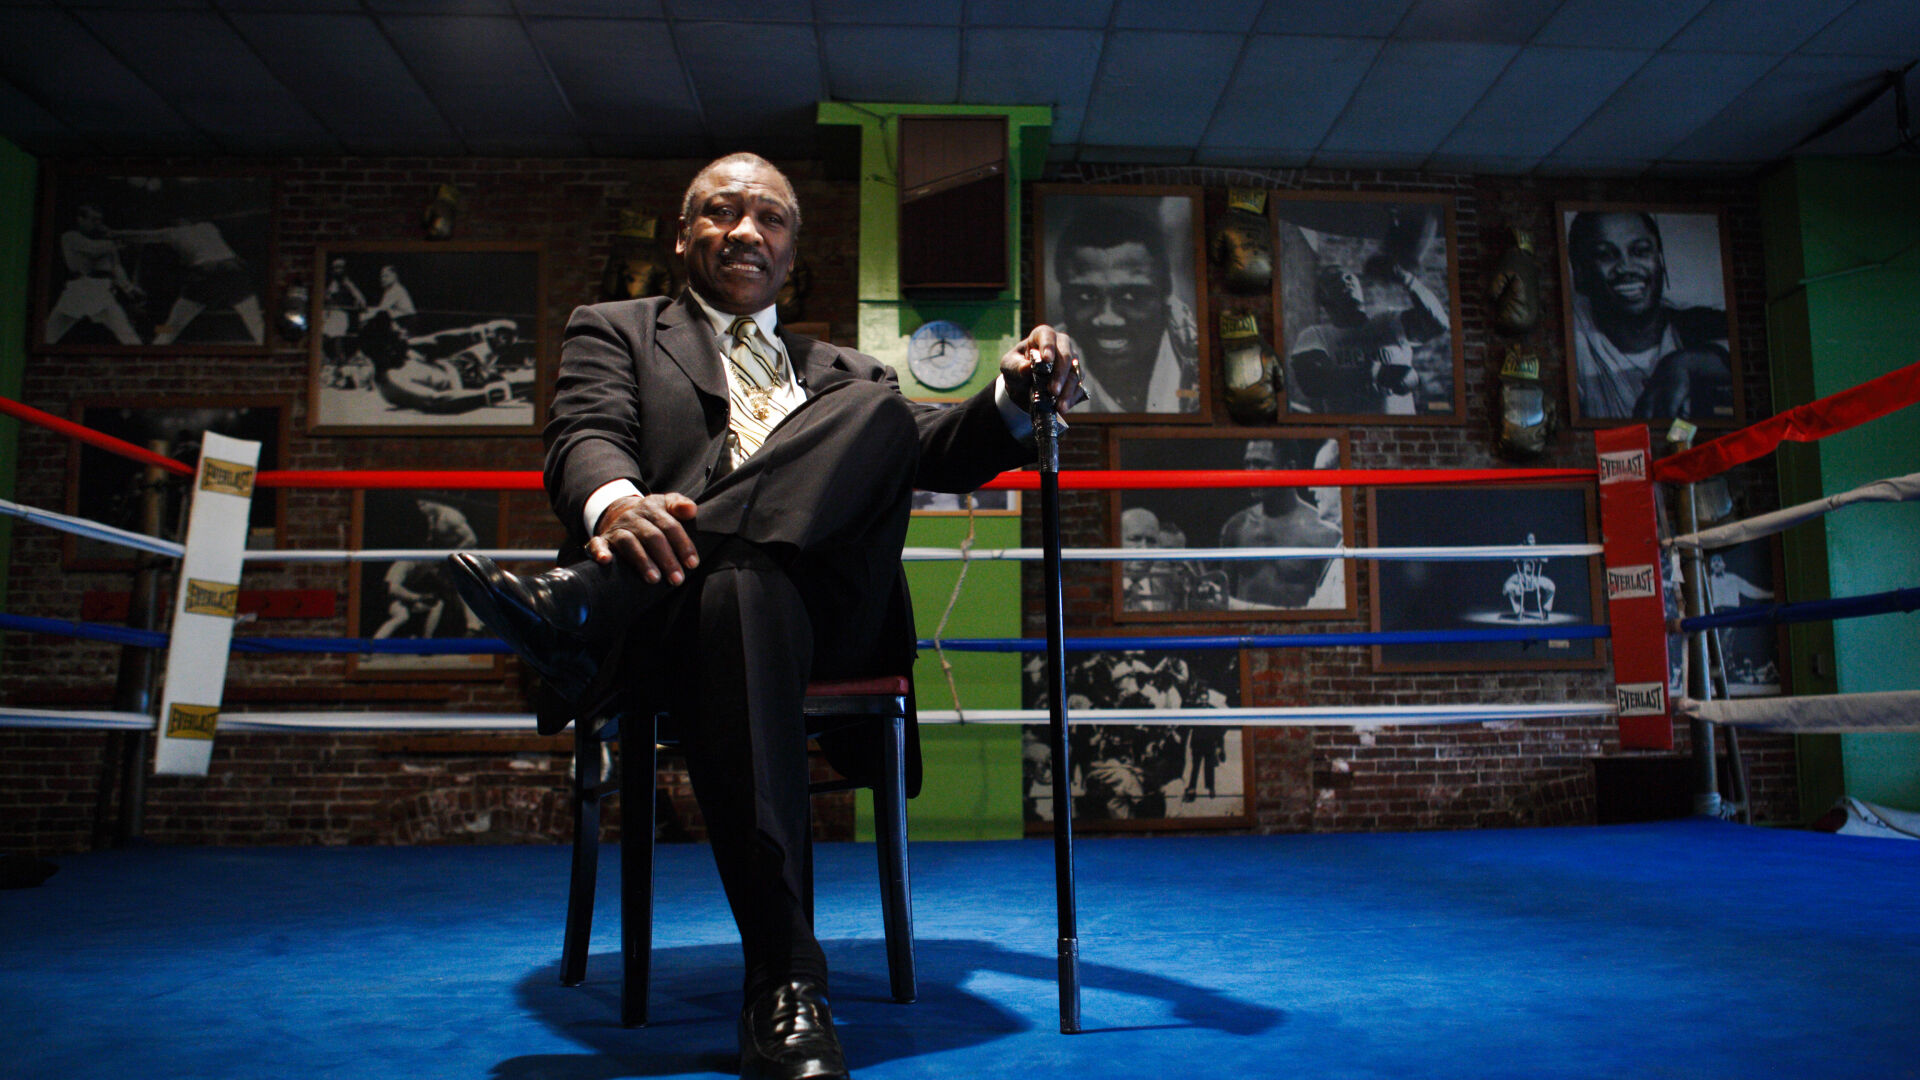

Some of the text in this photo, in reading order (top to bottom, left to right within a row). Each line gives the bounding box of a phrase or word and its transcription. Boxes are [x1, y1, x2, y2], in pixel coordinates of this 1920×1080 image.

[206, 462, 252, 490] EVERLAST
[1600, 454, 1643, 480] EVERLAST
[1608, 569, 1652, 596] EVERLAST
[188, 584, 236, 611] EVERLAST
[1618, 686, 1662, 712] EVERLAST
[170, 709, 217, 734] EVERLAST
